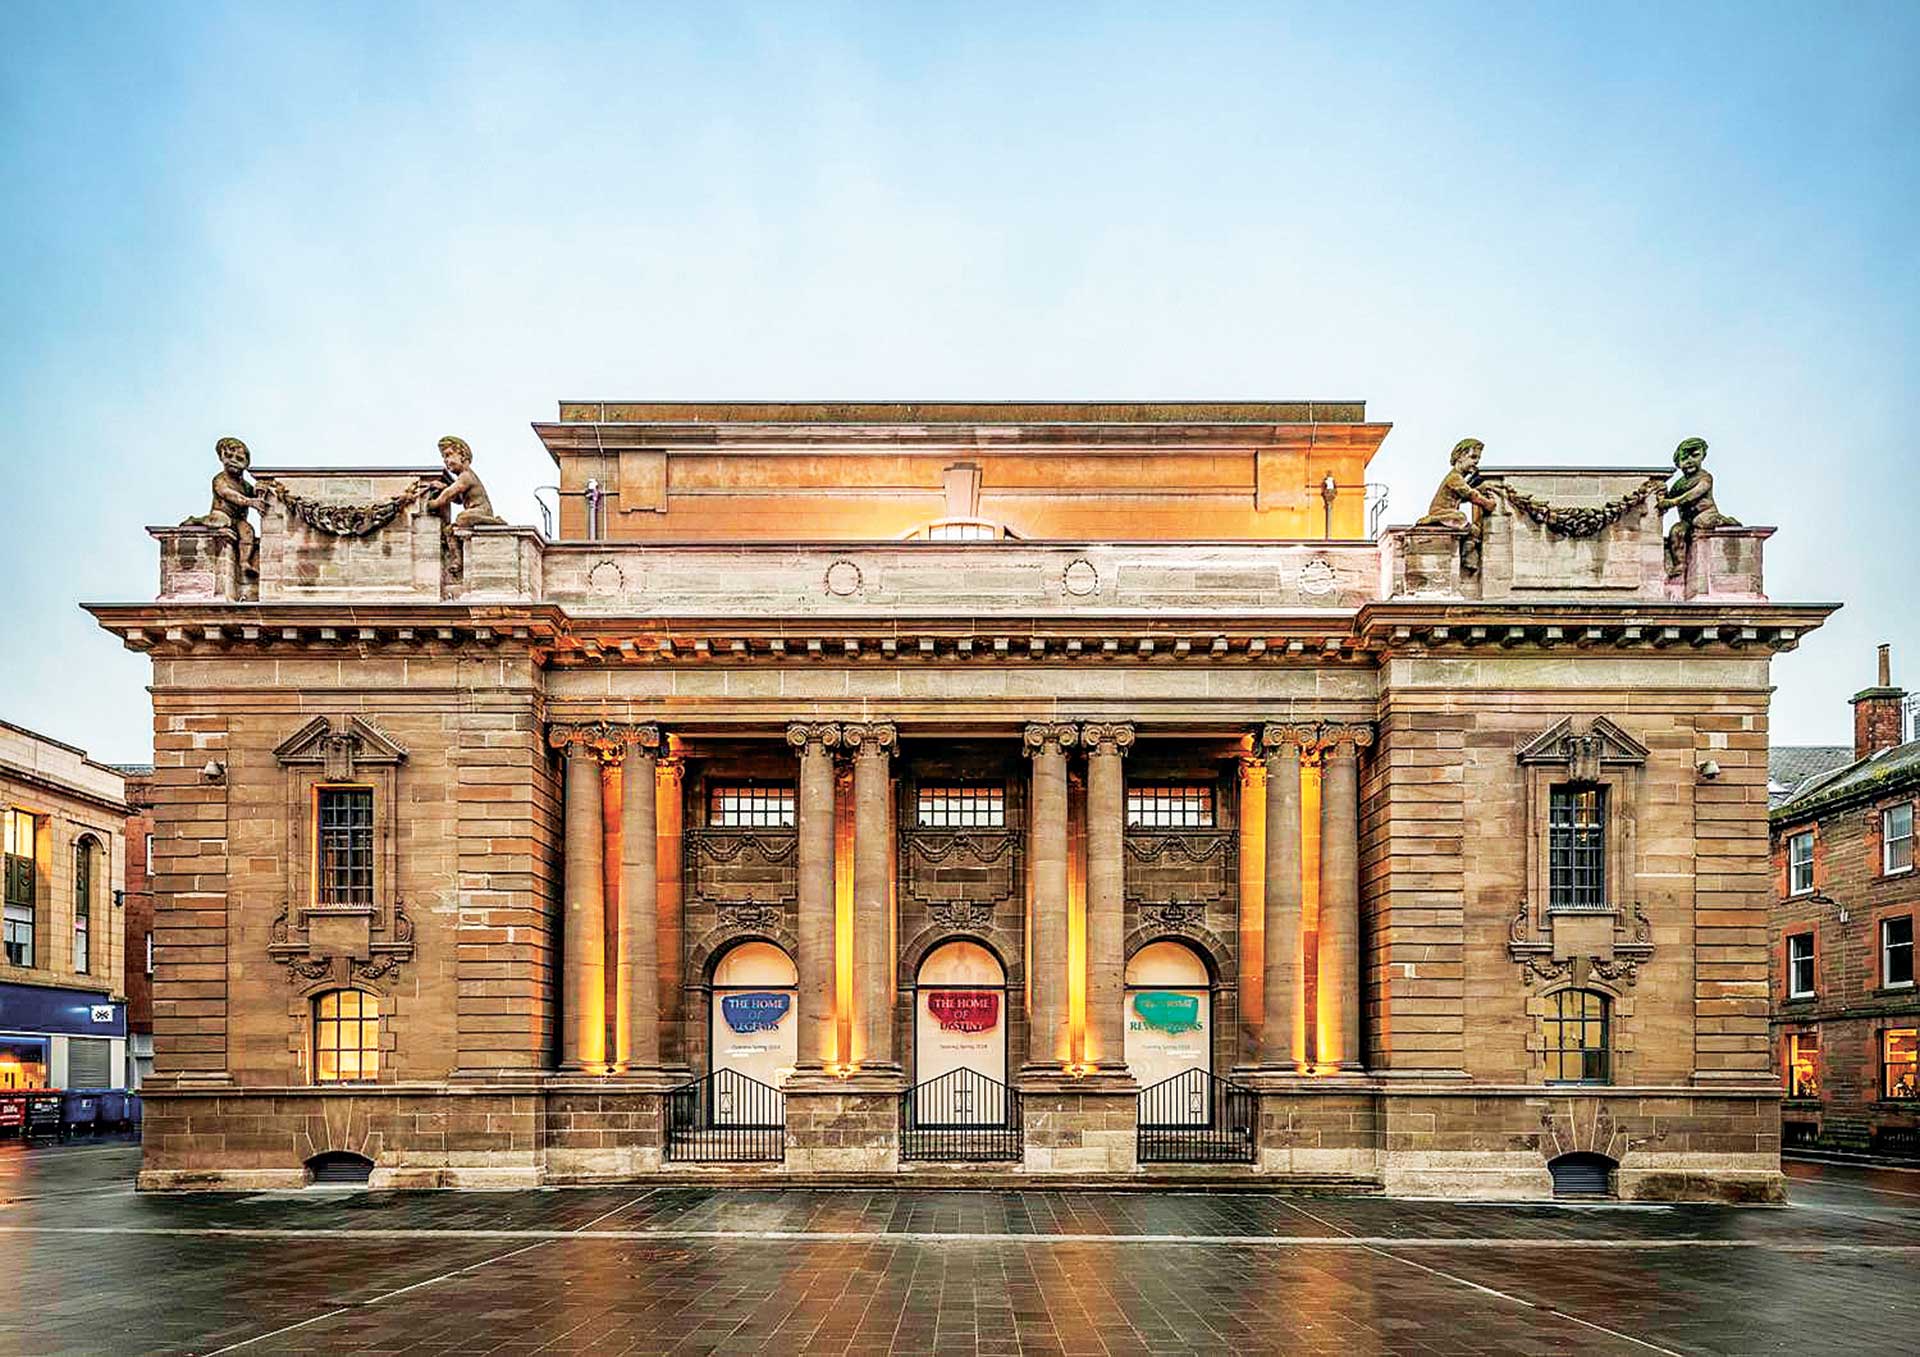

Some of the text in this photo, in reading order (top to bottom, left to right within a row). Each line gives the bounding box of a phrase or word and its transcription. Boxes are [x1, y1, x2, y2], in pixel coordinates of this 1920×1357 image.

[728, 999, 784, 1009] THE HOME
[934, 999, 990, 1009] THE HOME
[748, 1011, 766, 1020] OF
[953, 1010, 970, 1020] OF
[733, 1022, 780, 1031] LEGENDS
[940, 1021, 983, 1031] DESTINY
